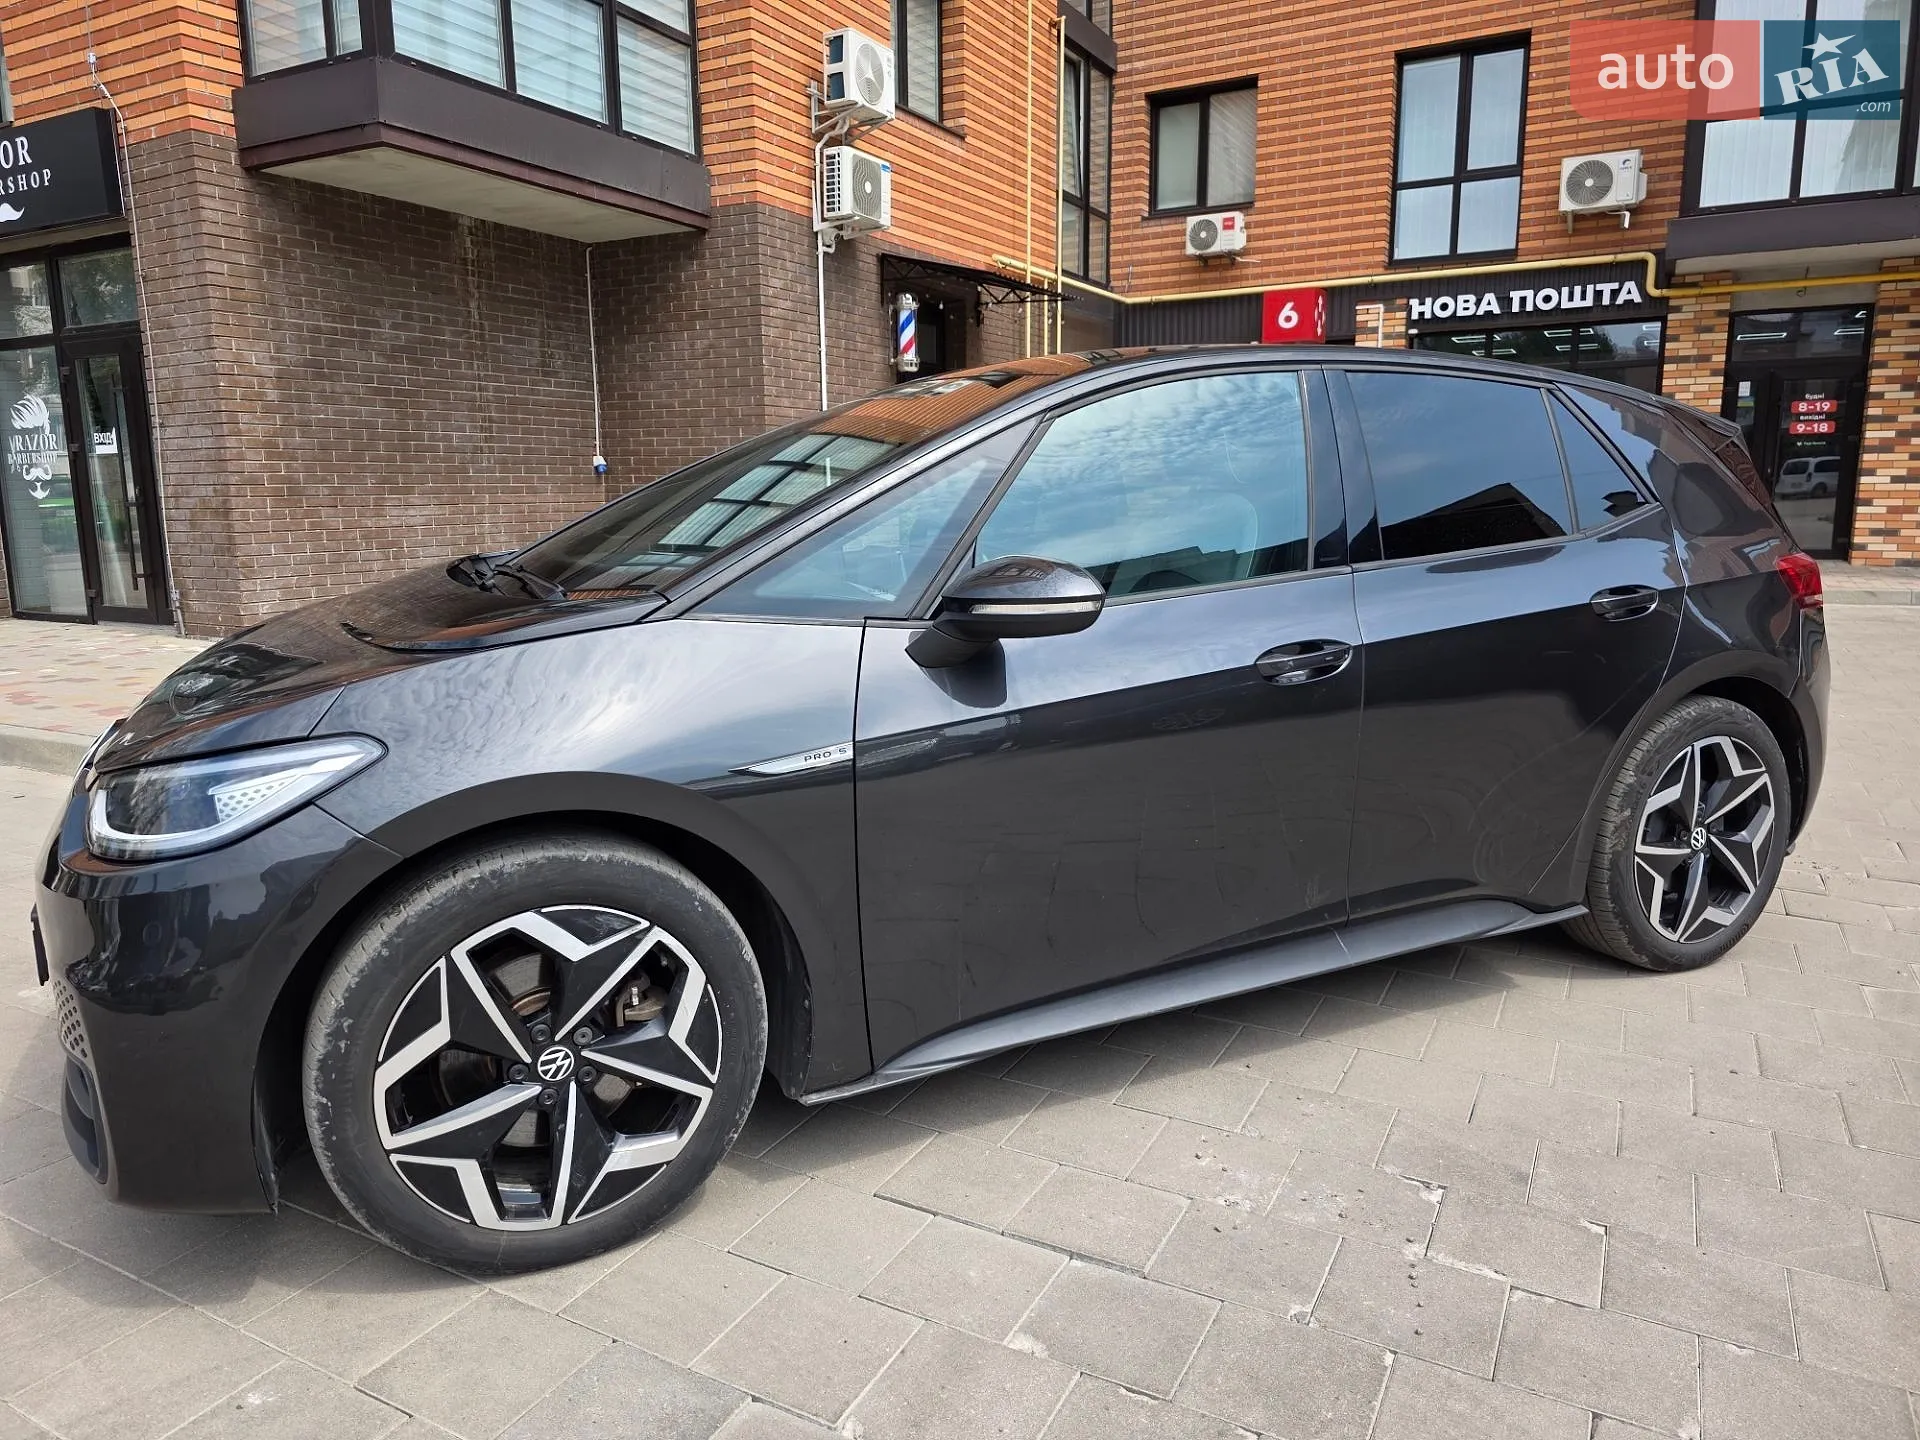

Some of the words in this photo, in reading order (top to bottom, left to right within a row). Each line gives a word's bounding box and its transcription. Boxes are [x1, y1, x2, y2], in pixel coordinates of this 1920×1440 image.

[1409, 292, 1501, 320] НОВА
[1510, 281, 1642, 313] ПОШТА
[1277, 303, 1298, 329] 6
[1798, 402, 1831, 412] 8-19
[1796, 422, 1829, 433] 9-18
[804, 752, 832, 762] PRO
